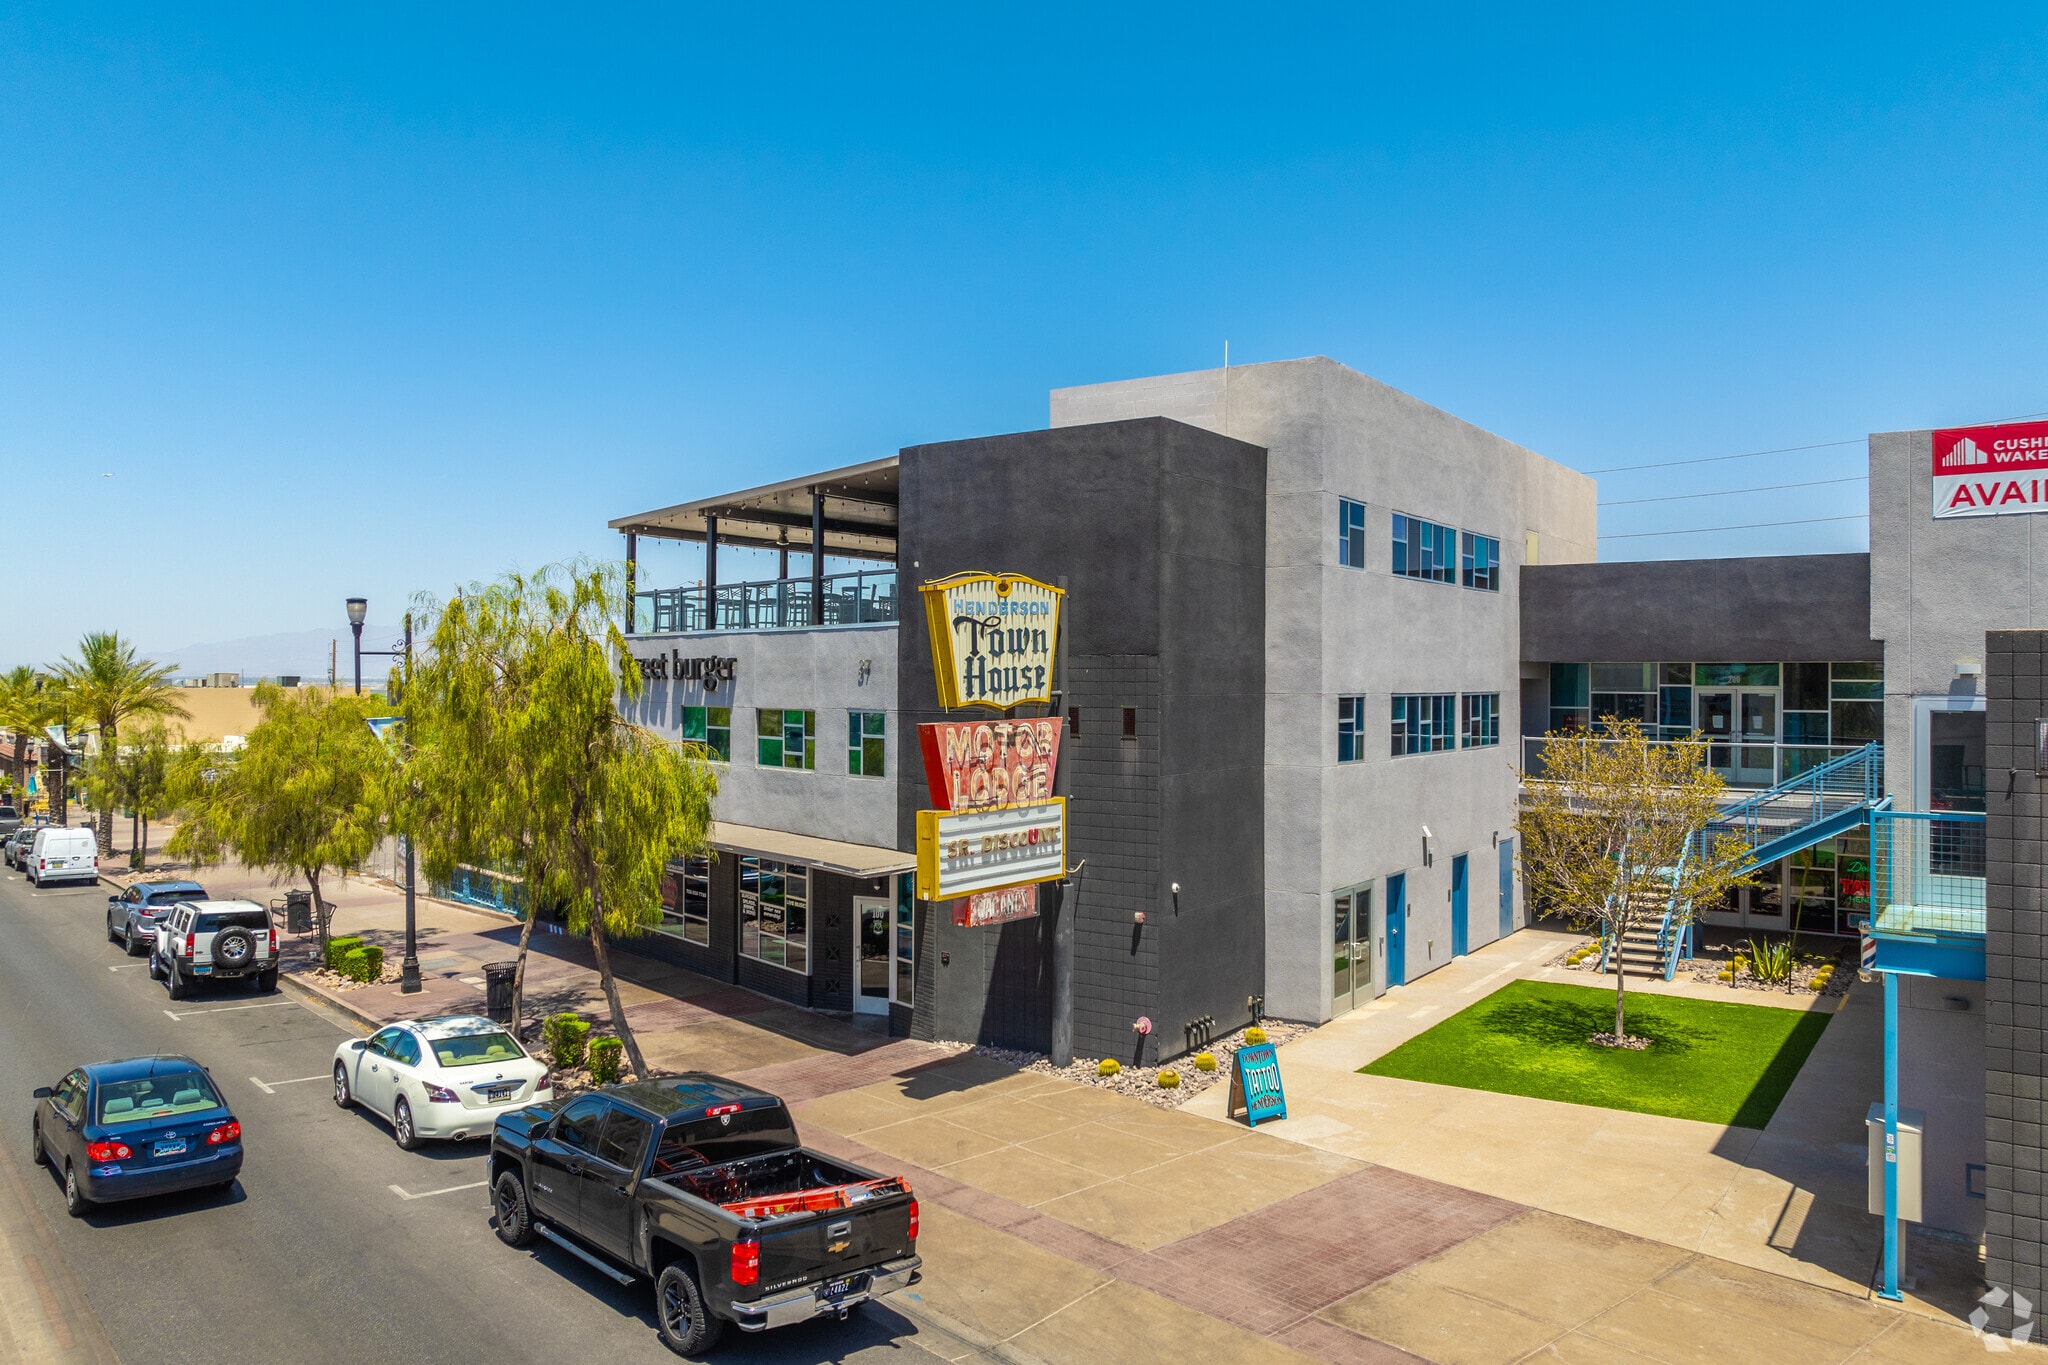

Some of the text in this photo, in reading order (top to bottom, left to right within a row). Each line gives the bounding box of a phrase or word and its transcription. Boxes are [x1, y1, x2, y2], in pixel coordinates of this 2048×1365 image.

[953, 599, 1049, 616] HENDERSON
[953, 615, 1049, 657] Town
[672, 649, 738, 691] burger
[963, 654, 1046, 698] House
[946, 721, 1053, 763] MOTOR
[951, 764, 1048, 811] LODGE
[948, 825, 1061, 859] SR. DISCOUNT
[1245, 1062, 1280, 1098] TATTOO
